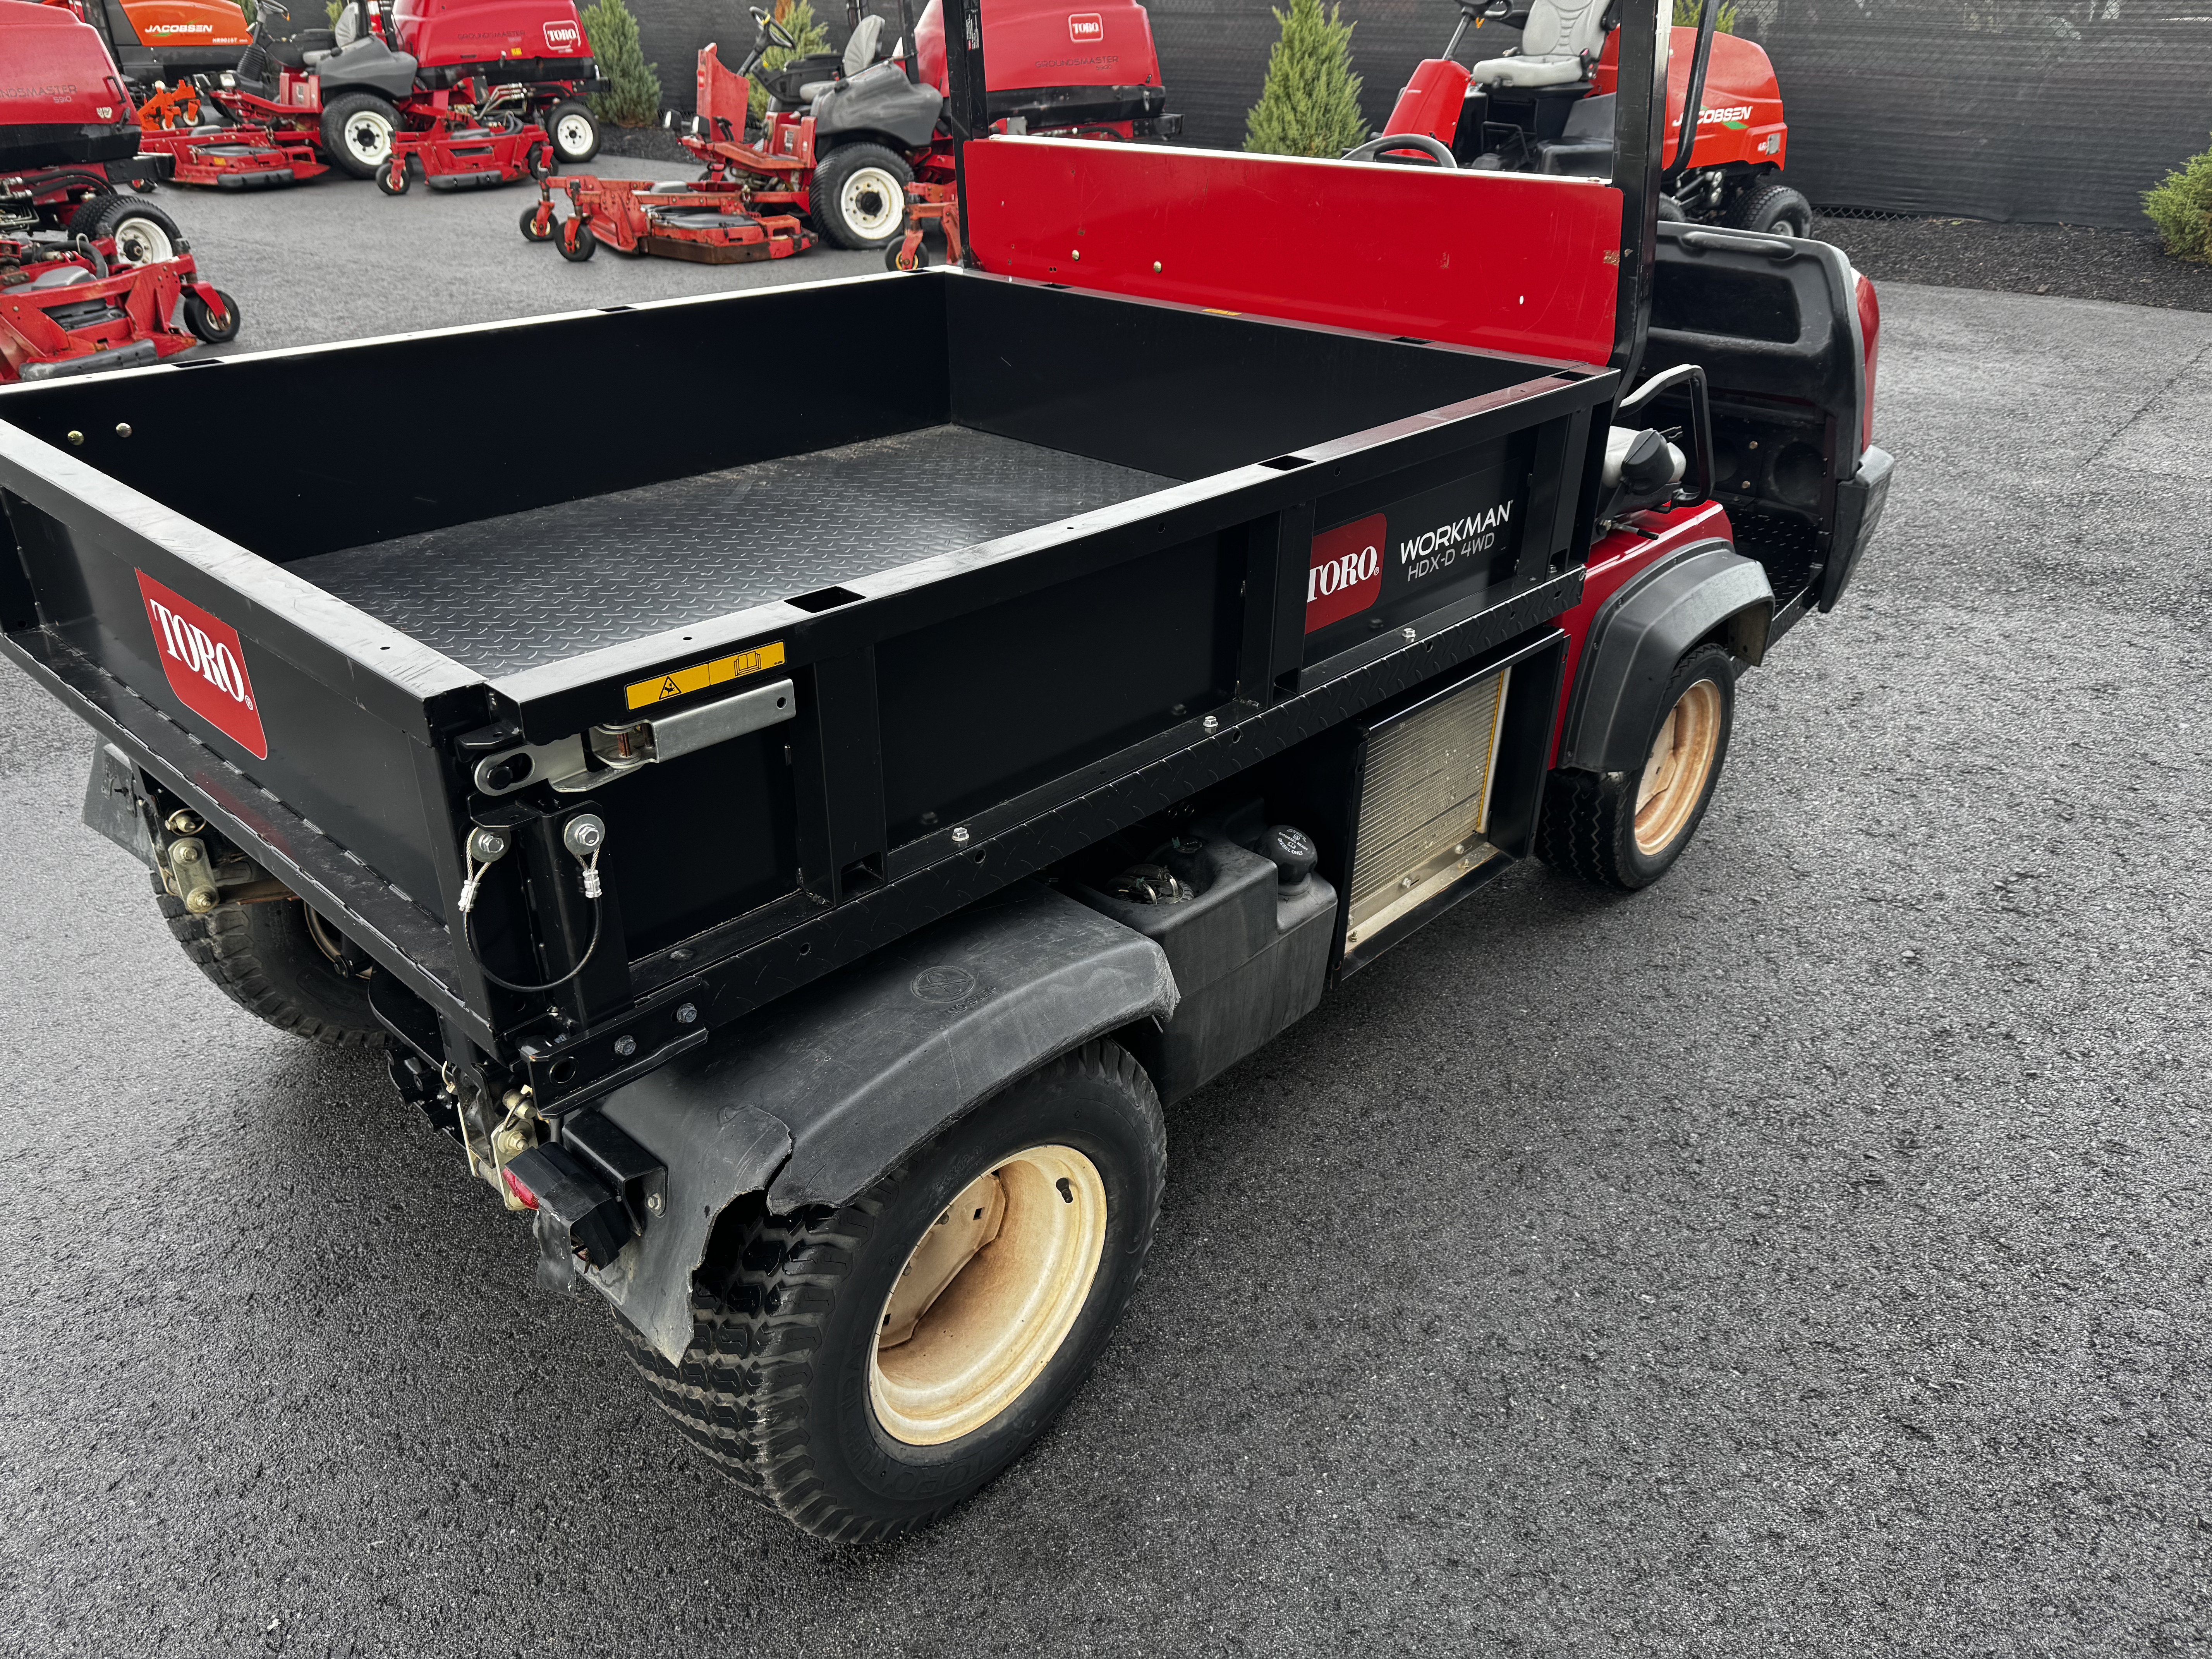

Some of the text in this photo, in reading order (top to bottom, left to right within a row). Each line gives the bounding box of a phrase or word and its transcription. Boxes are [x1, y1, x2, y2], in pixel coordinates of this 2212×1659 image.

[547, 29, 576, 41] TORO
[1072, 22, 1099, 34] TORO
[1035, 56, 1118, 68] GROUNDSMASTER
[1672, 106, 1752, 126] JCOBSEN
[1400, 500, 1513, 564] WORKMAN
[1408, 532, 1495, 582] HDX-D 4WD
[150, 598, 246, 702] TORO
